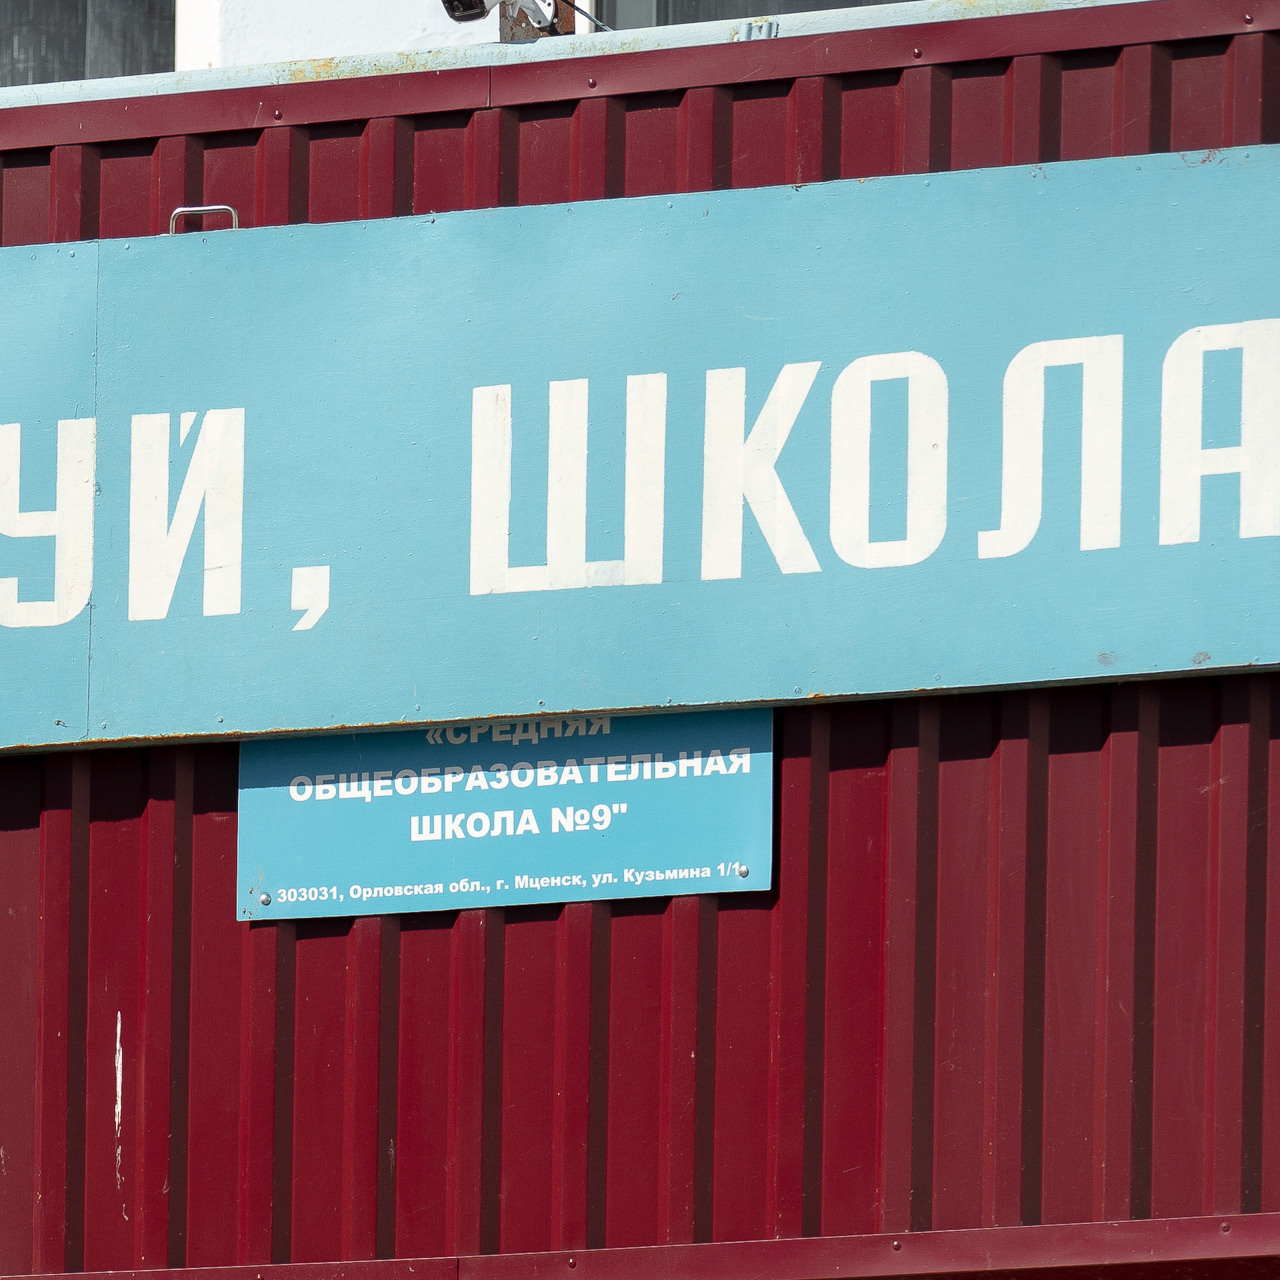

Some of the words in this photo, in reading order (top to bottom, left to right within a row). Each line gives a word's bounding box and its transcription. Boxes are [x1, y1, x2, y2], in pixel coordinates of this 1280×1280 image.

[470, 318, 1280, 595] ШКОЛА
[289, 747, 752, 802] ОБЩЕОБРАЗОВАТЕЛЬНАЯ
[410, 808, 540, 842] ШКОЛА
[551, 803, 628, 834] №9"
[277, 885, 344, 903] 303031,
[349, 880, 444, 901] Орловская
[449, 876, 491, 894] обл.,
[496, 880, 509, 892] г.
[514, 874, 587, 891] Мценск,
[592, 873, 617, 887] ул.
[624, 864, 711, 884] Кузьмина
